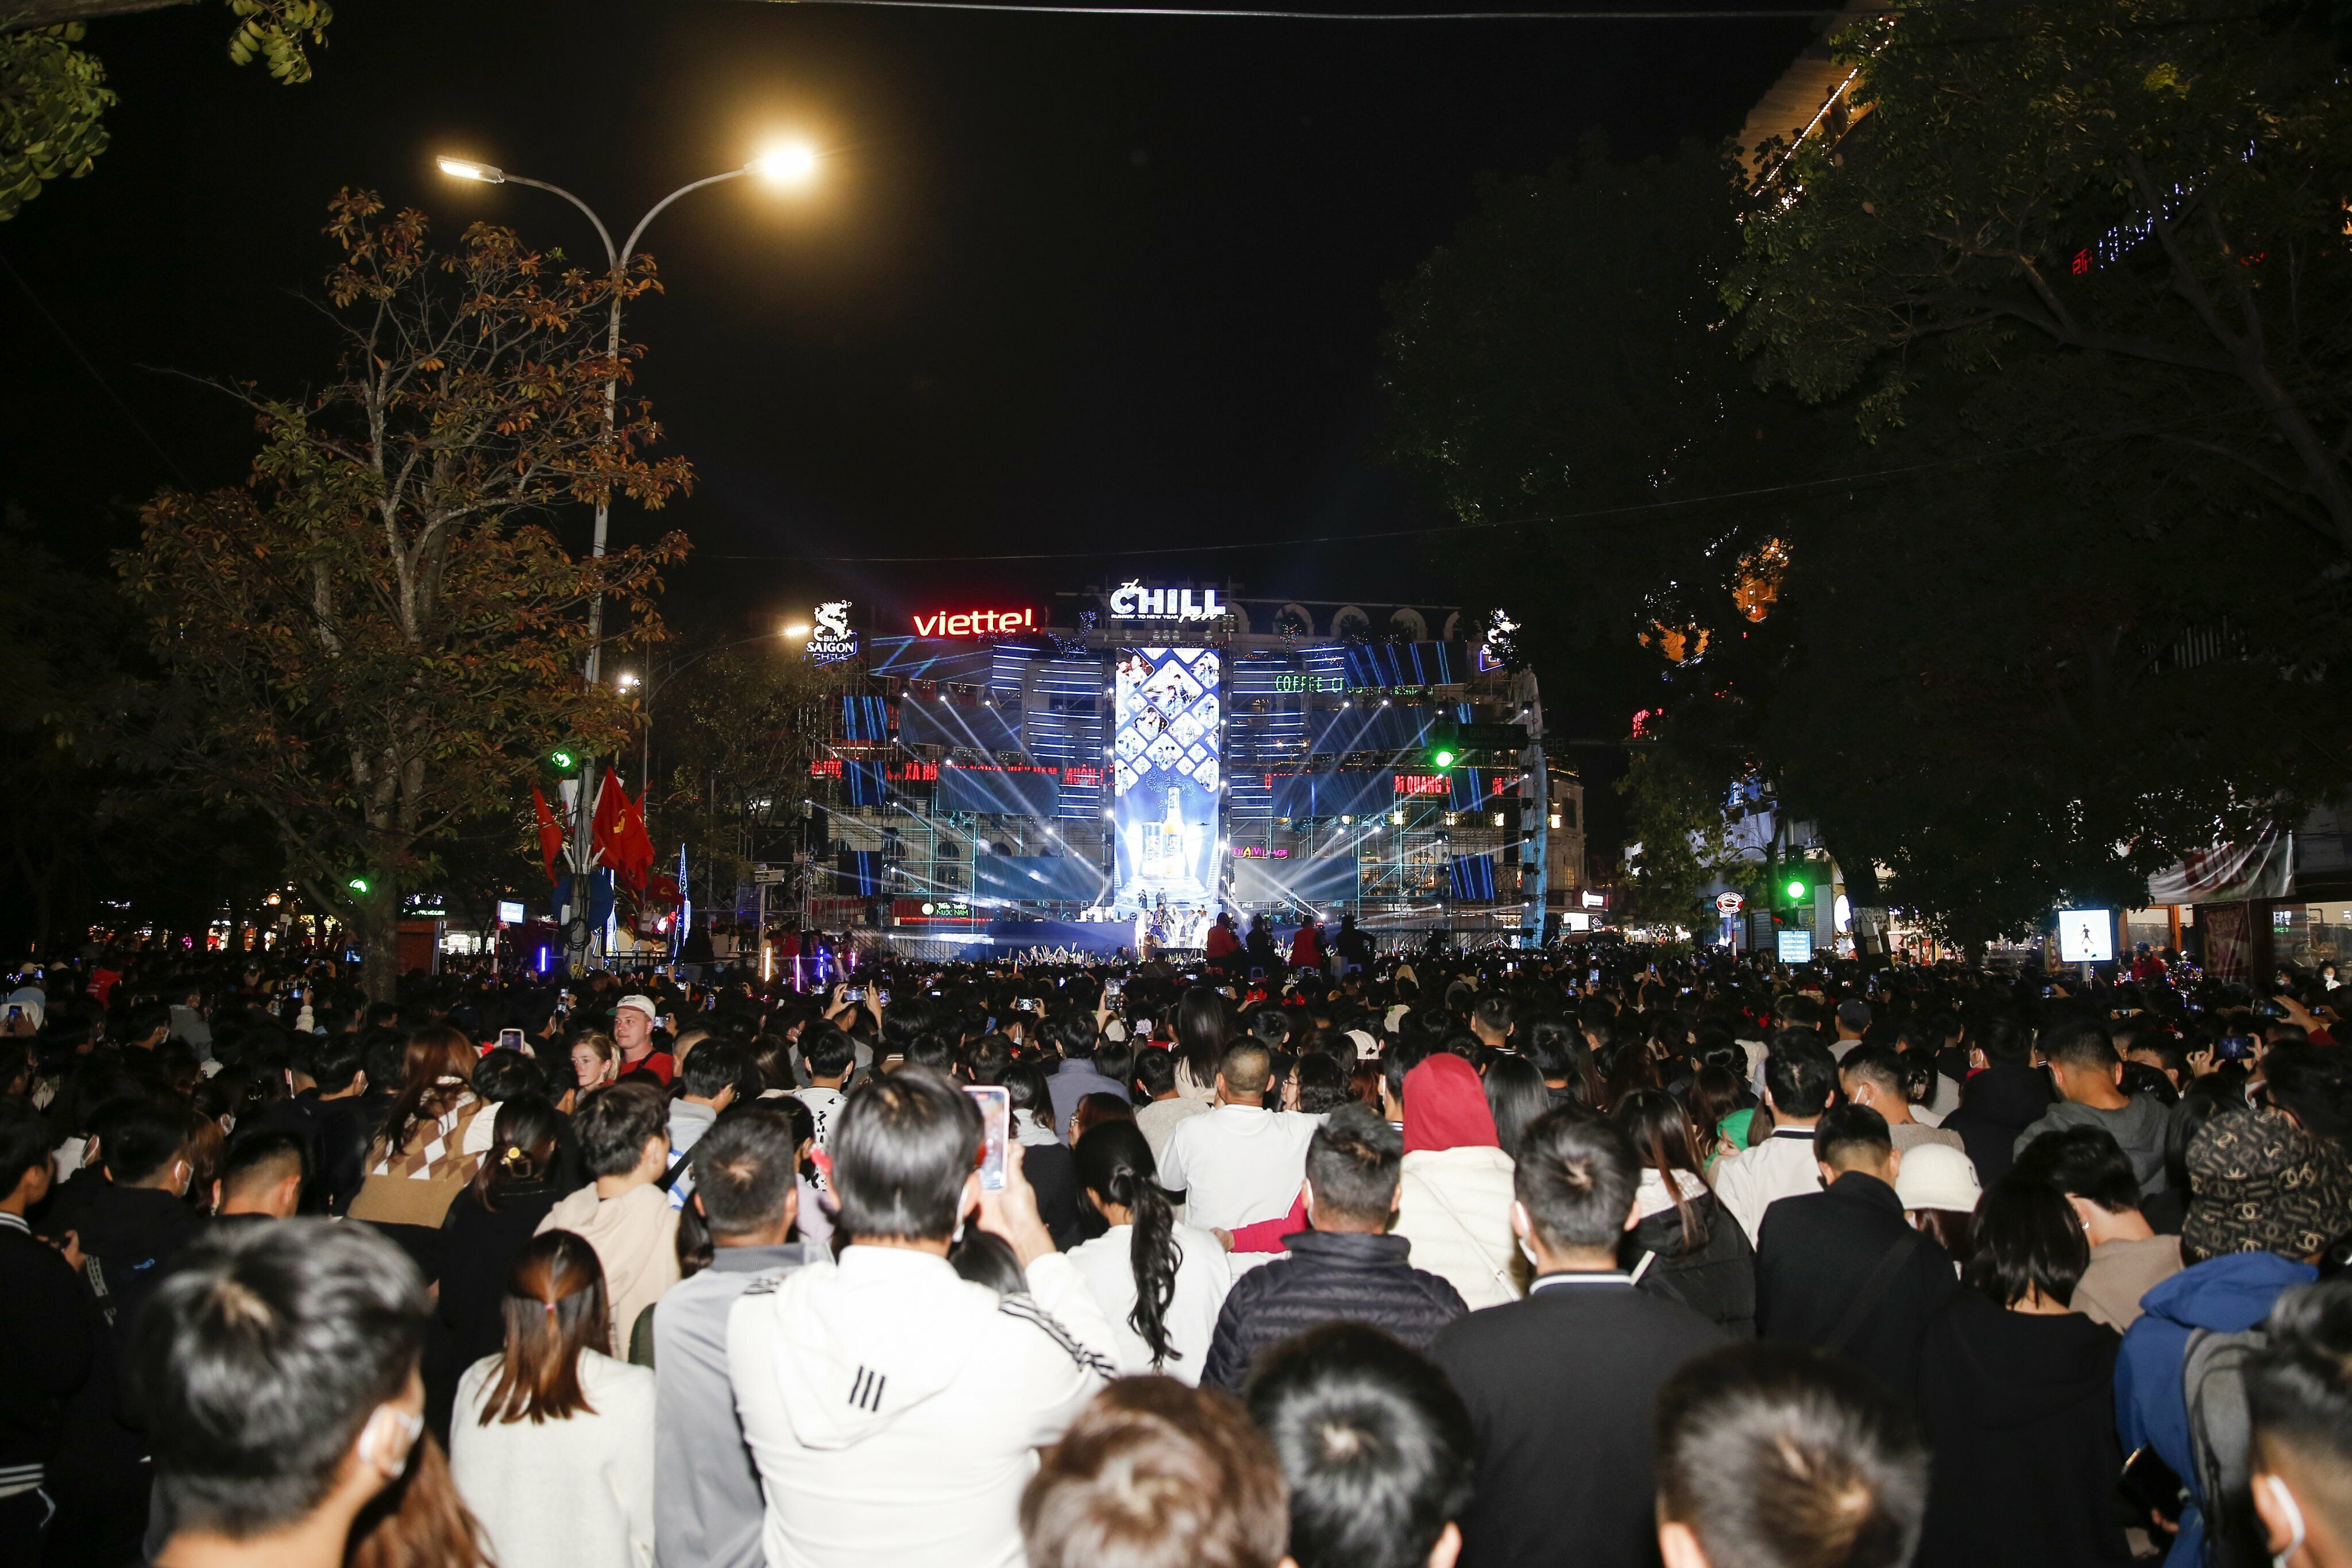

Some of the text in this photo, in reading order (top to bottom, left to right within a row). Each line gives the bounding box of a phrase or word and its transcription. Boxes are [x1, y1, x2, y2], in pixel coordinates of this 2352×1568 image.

[1110, 588, 1226, 615] CHILL
[806, 642, 855, 652] SAIGON
[1275, 675, 1323, 692] COFFEE
[1407, 775, 1442, 794] QUANG
